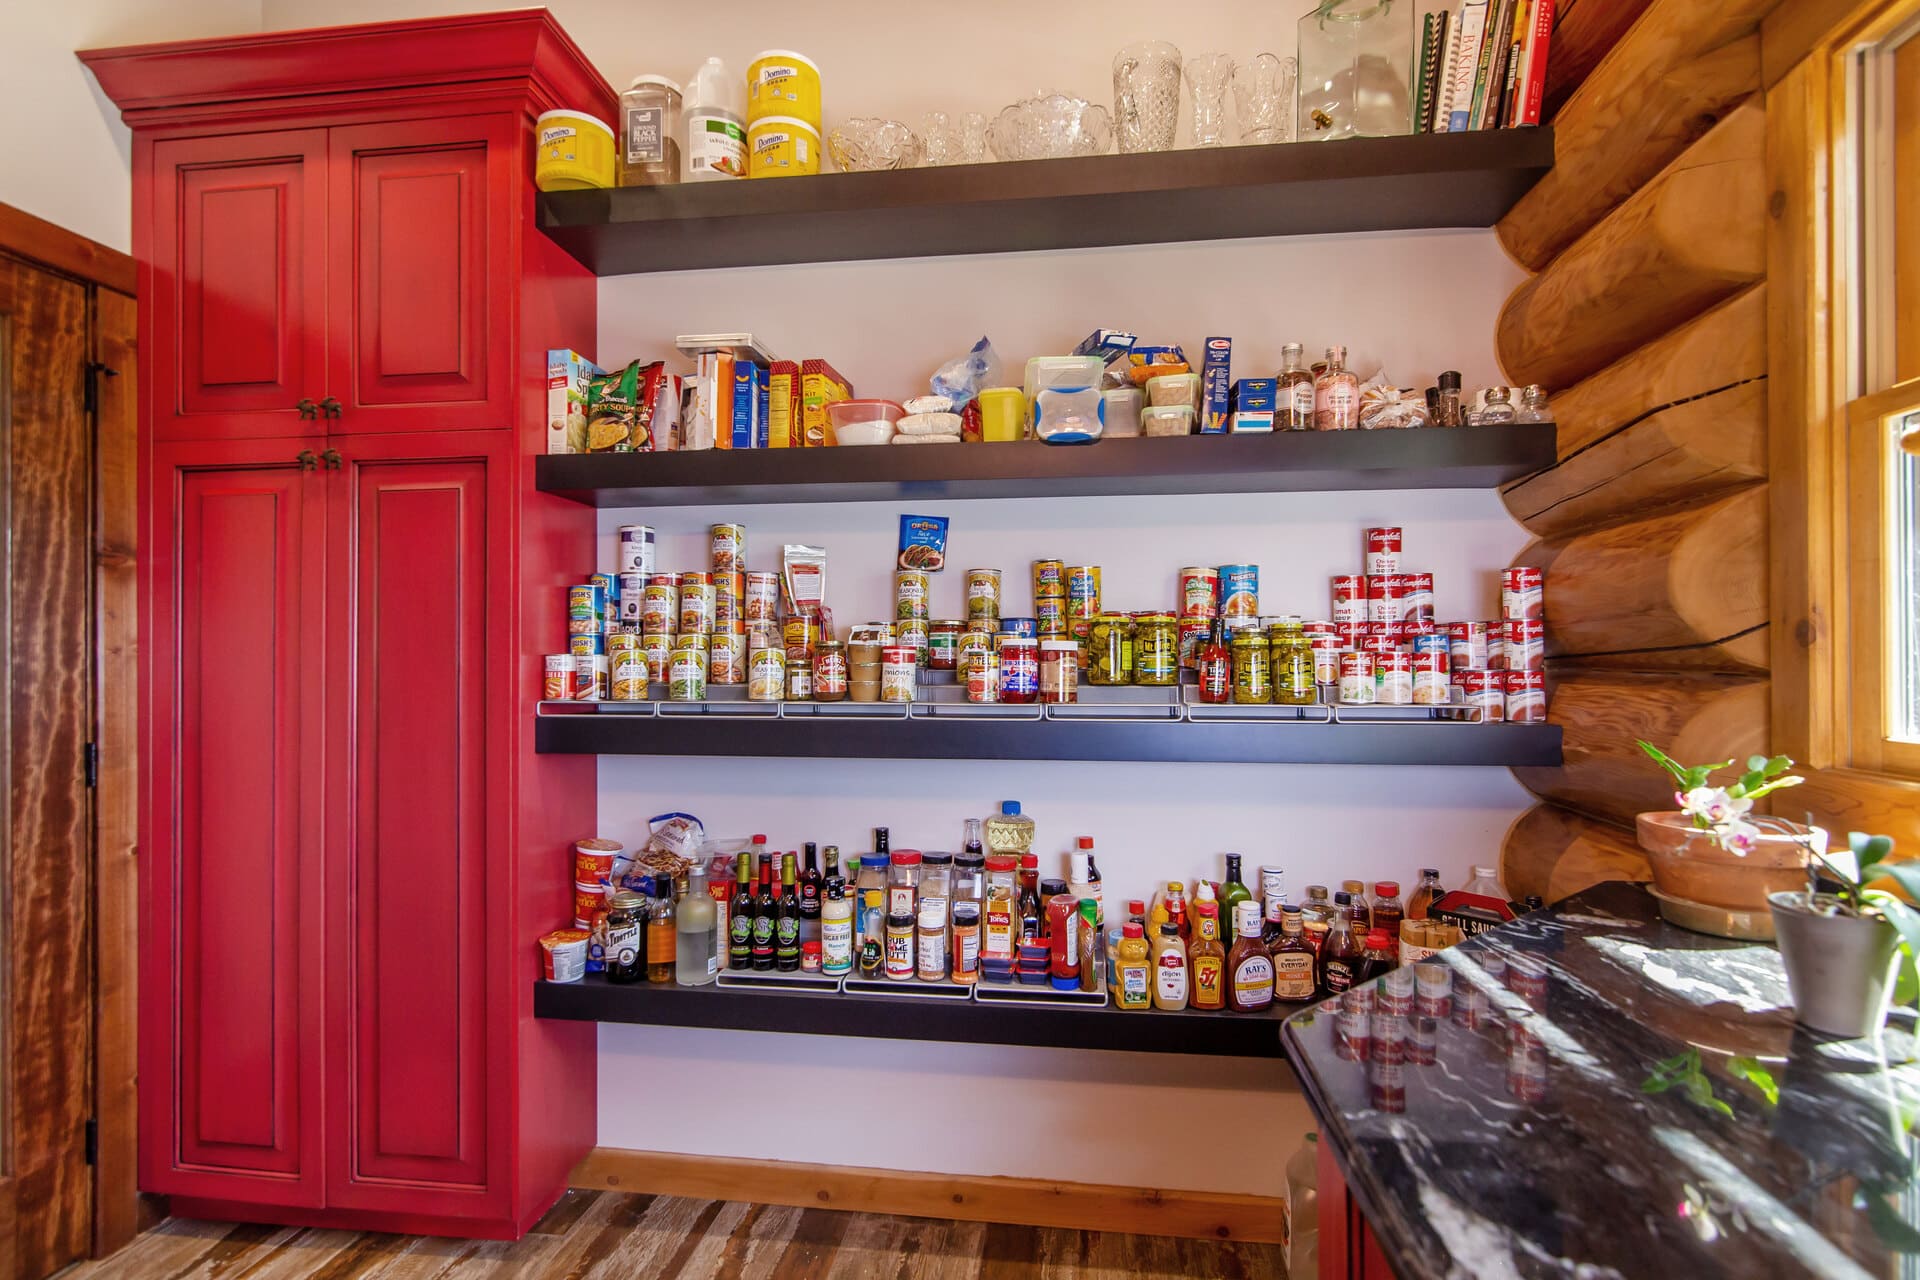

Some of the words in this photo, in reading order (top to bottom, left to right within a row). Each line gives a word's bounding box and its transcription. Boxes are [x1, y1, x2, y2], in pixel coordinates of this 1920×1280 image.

[1455, 35, 1476, 93] BAKING
[764, 68, 791, 81] Domino
[767, 78, 788, 86] SUGAR
[544, 129, 570, 142] Domino
[633, 129, 657, 137] BLACK
[758, 135, 784, 150] Domino
[591, 579, 609, 587] USH'S
[571, 591, 592, 599] BUSH'S
[610, 927, 637, 948] THROTTLE
[888, 937, 905, 945] RUB
[1245, 964, 1267, 975] RAY'S
[1280, 961, 1309, 969] EVERYDAY
[1199, 967, 1217, 987] 57
